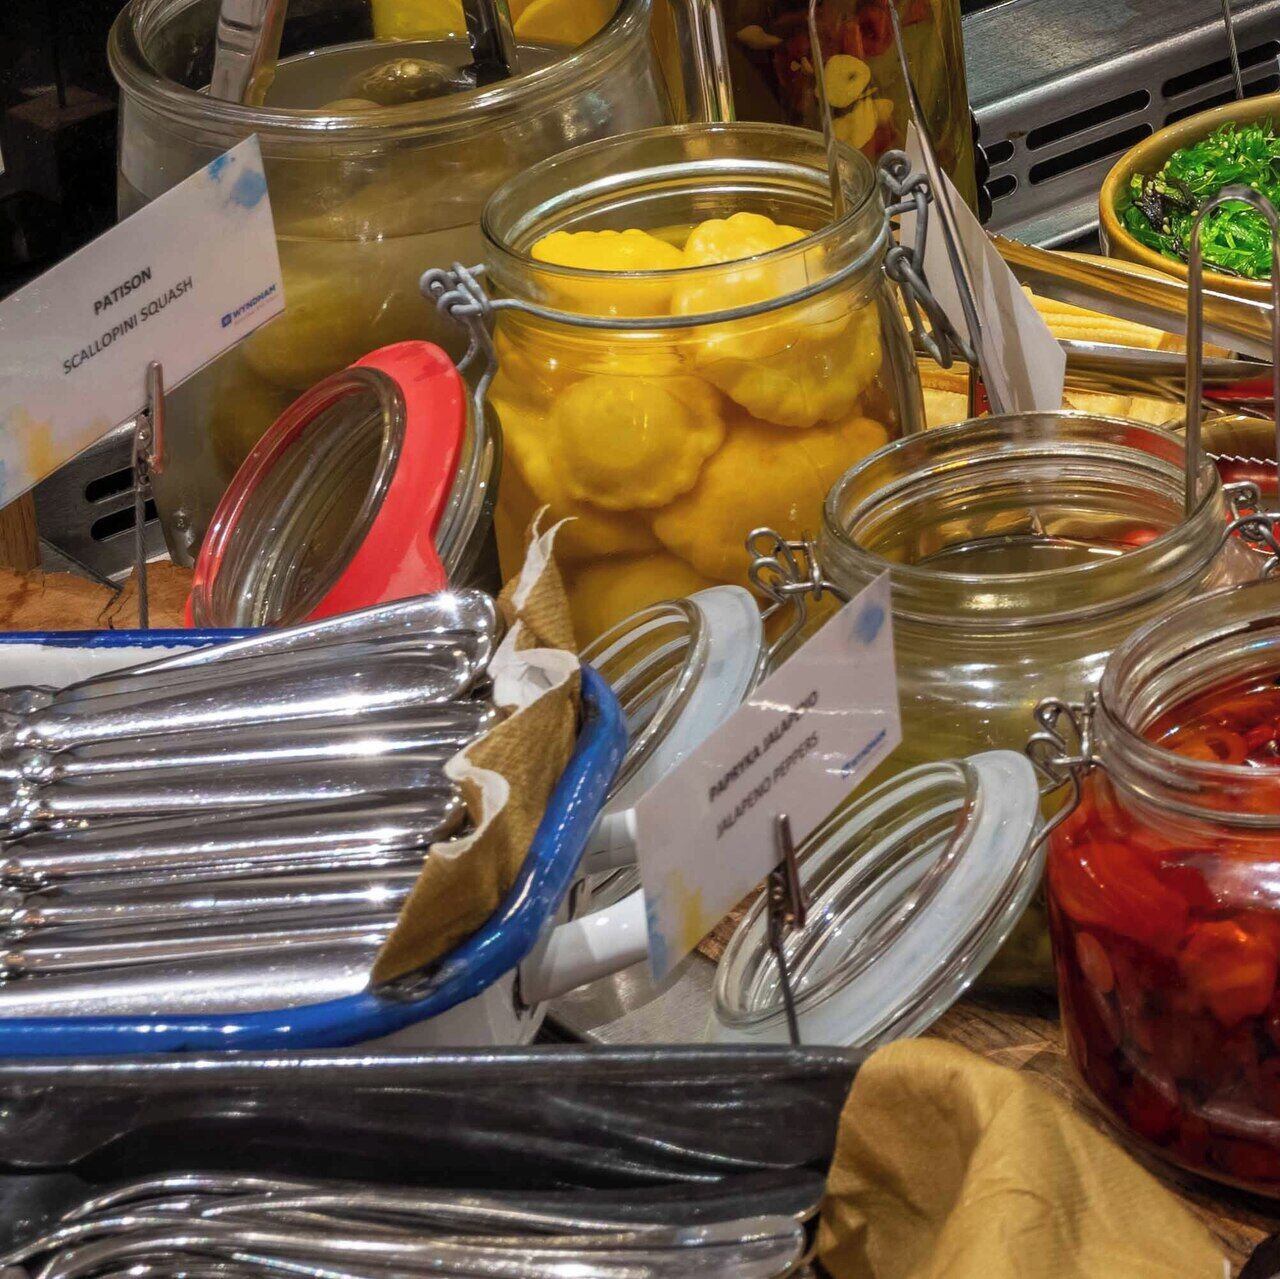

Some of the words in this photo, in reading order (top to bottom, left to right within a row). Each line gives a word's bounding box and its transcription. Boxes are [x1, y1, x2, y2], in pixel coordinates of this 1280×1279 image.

[93, 266, 152, 316] PATISON
[232, 284, 276, 318] WYNDHAM
[62, 314, 138, 375] SCALLOPINI
[140, 276, 194, 322] SQUASH
[772, 730, 818, 781] PEPPERS
